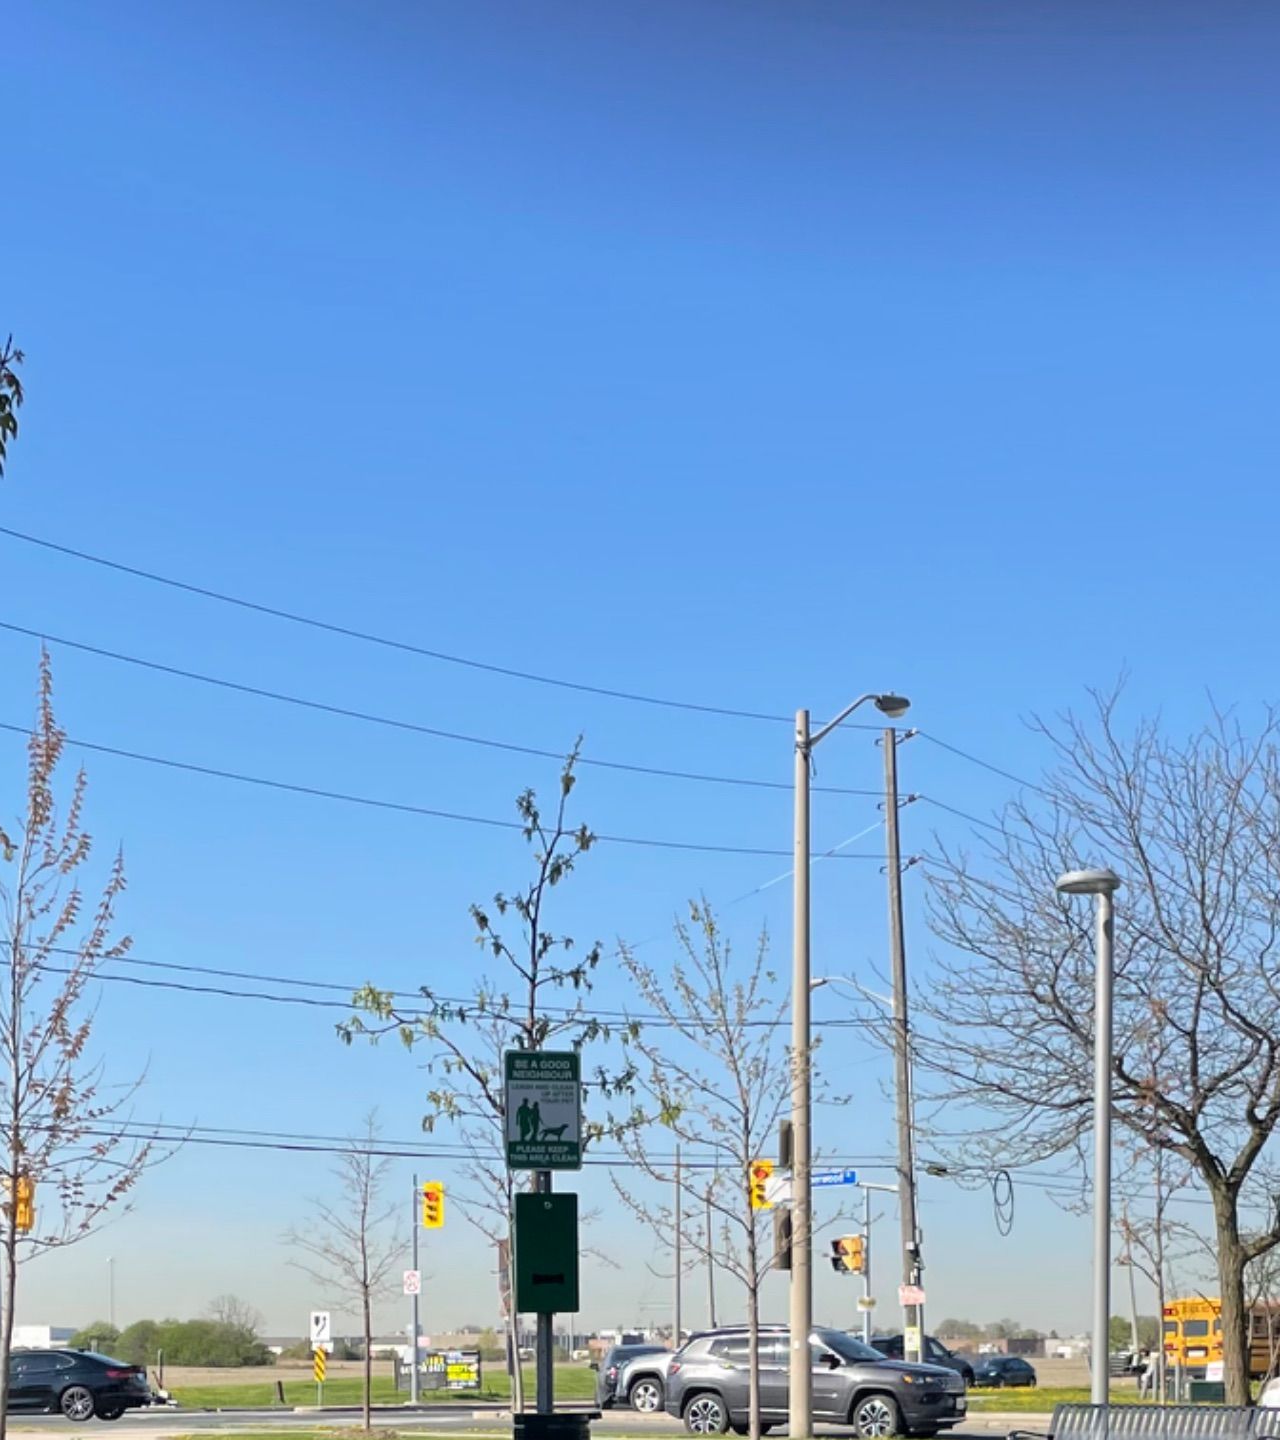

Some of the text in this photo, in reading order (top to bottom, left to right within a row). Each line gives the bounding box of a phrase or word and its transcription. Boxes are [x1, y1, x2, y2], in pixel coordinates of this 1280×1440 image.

[514, 1060, 570, 1069] BE A GOOD
[511, 1070, 572, 1079] NEIGHBOUR
[515, 1145, 569, 1153] PLEASE KEEP
[510, 1153, 578, 1162] THIS AREA CLEAN
